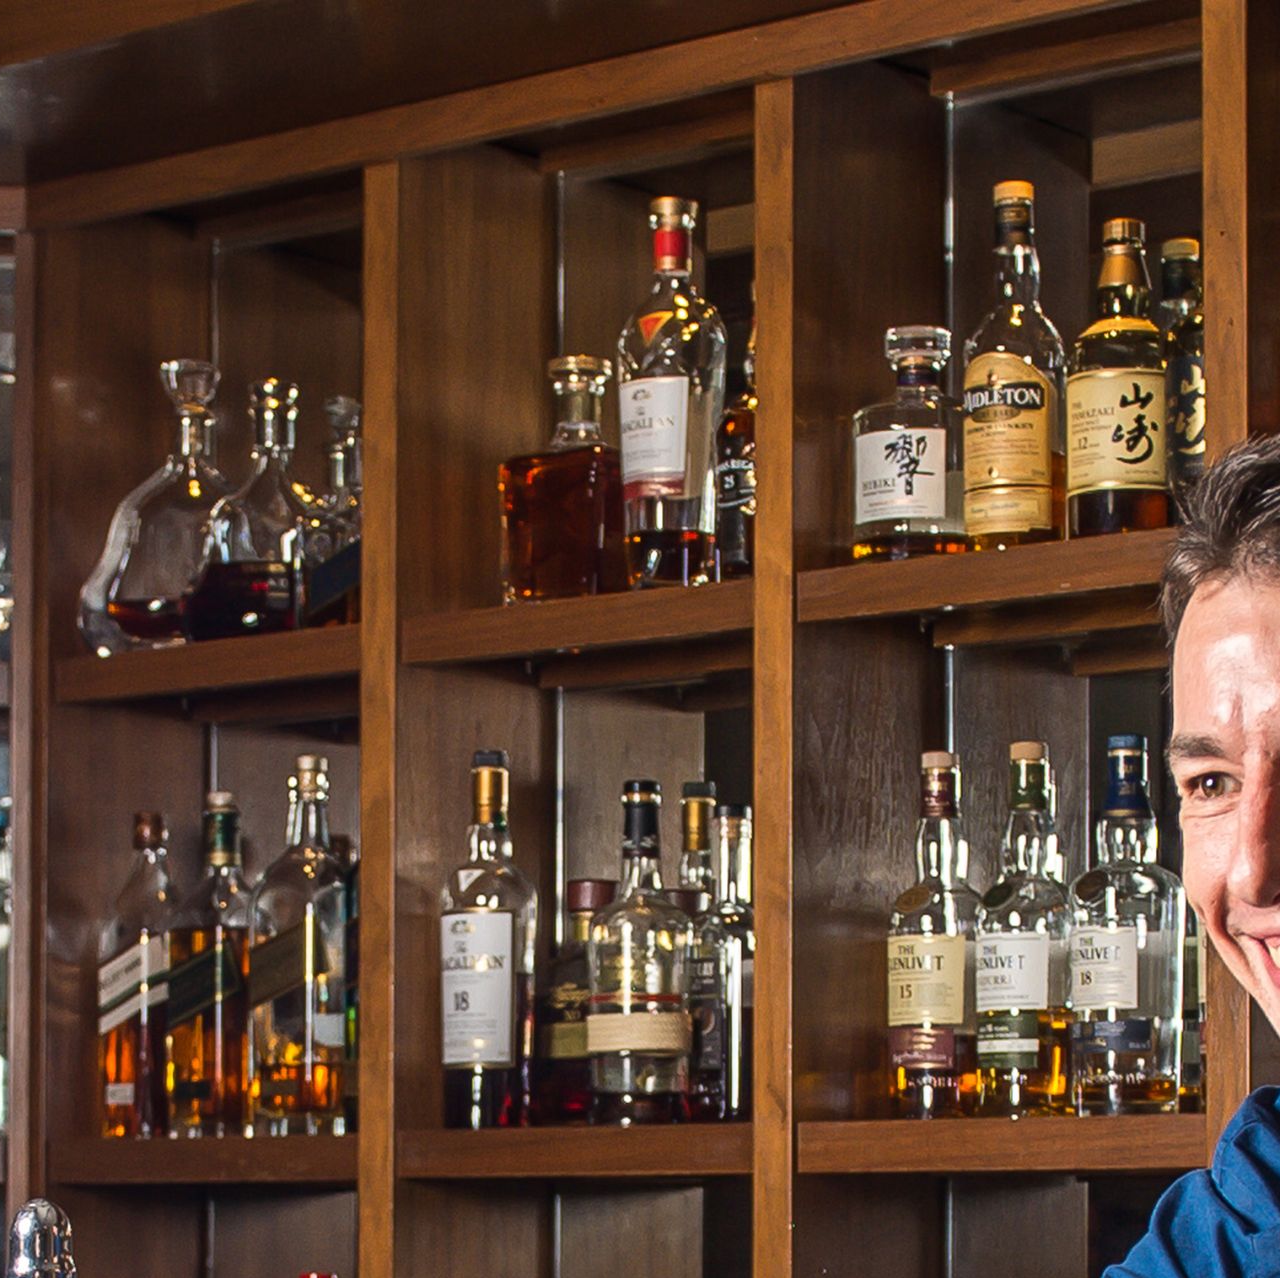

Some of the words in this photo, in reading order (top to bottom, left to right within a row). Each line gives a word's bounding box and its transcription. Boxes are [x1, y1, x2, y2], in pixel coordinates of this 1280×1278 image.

[1078, 436, 1089, 450] 12
[862, 478, 896, 492] HIBIKI
[897, 944, 916, 956] THE
[1080, 970, 1093, 986] 18
[899, 983, 913, 1000] 15
[453, 990, 471, 1013] 18
